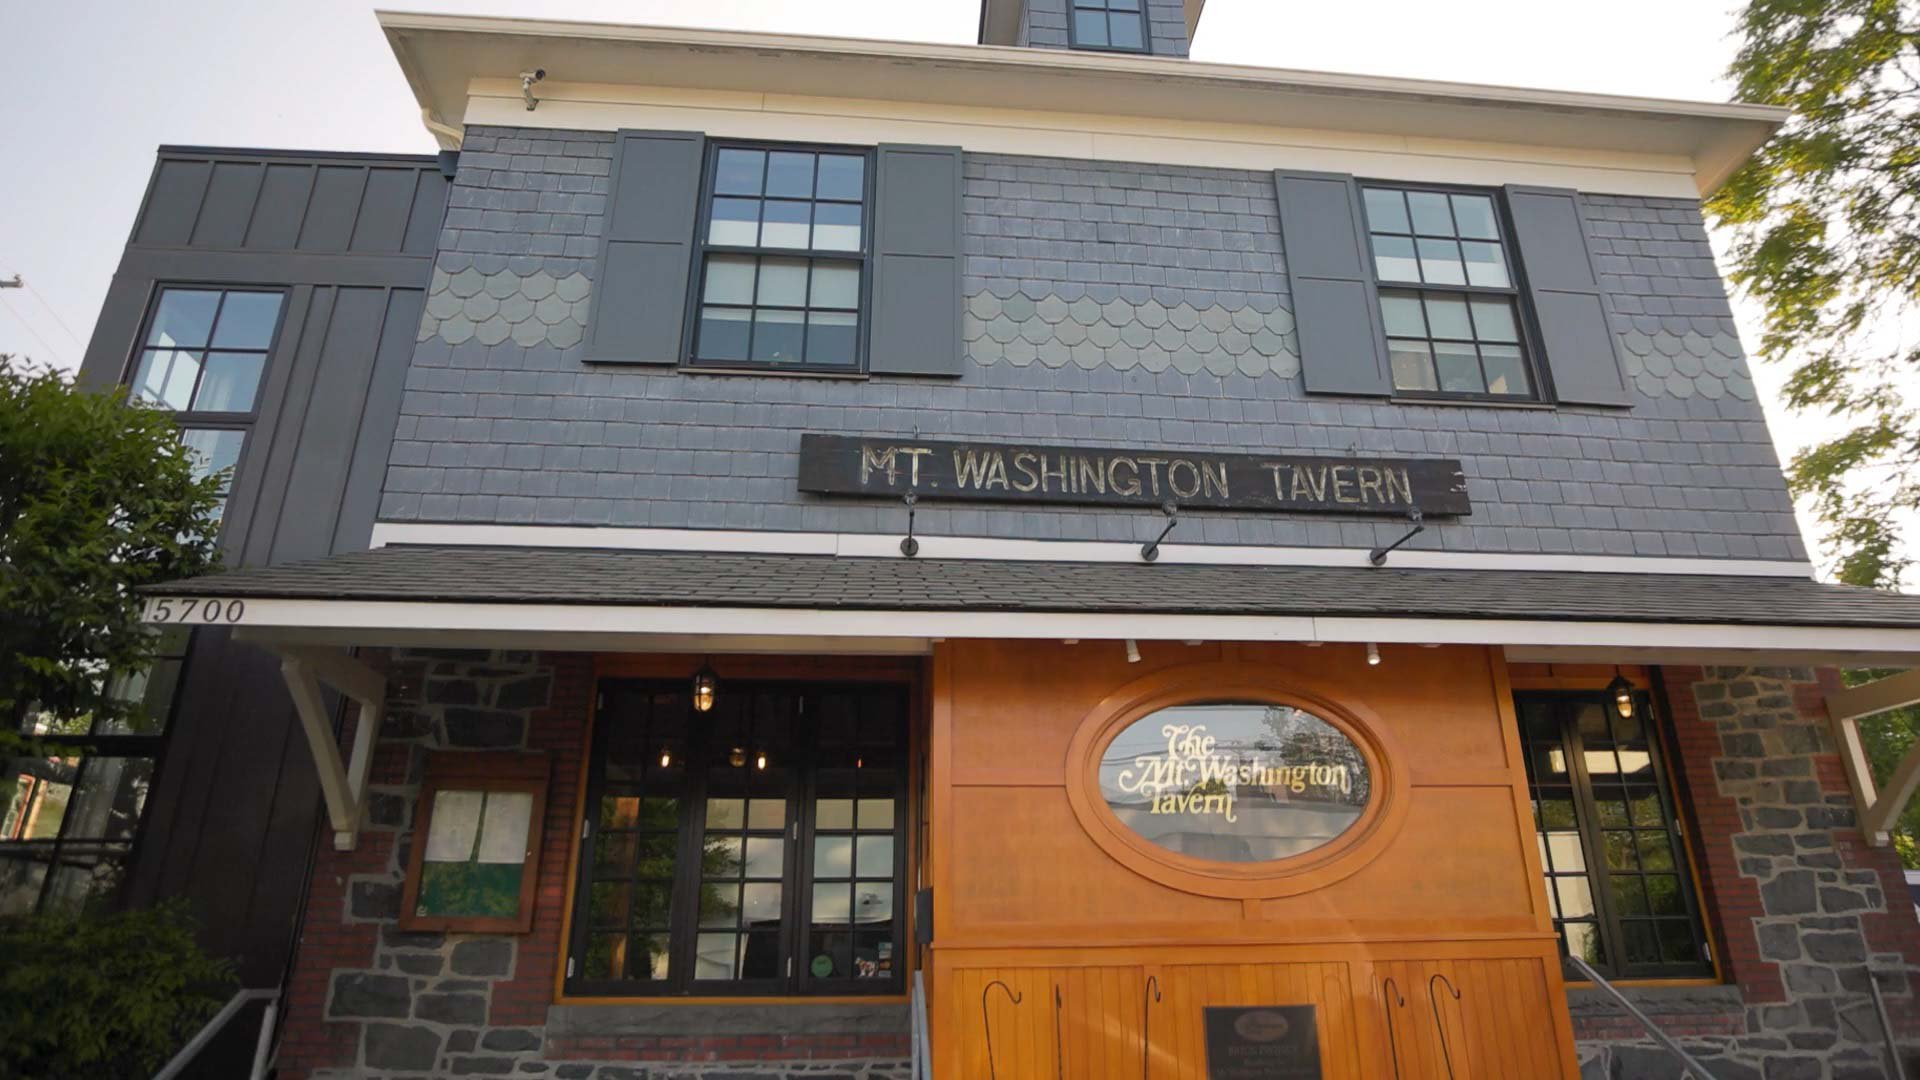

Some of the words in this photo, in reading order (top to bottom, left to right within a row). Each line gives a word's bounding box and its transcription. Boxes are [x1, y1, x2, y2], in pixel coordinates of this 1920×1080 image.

[862, 446, 938, 487] MT.
[953, 449, 1229, 498] WASHINGTON
[1261, 462, 1412, 505] TAVERN
[153, 599, 245, 623] 5700
[1162, 724, 1216, 761] The
[1118, 755, 1190, 793] Mt.
[1184, 754, 1350, 794] Washington
[1140, 783, 1237, 823] Tavern
